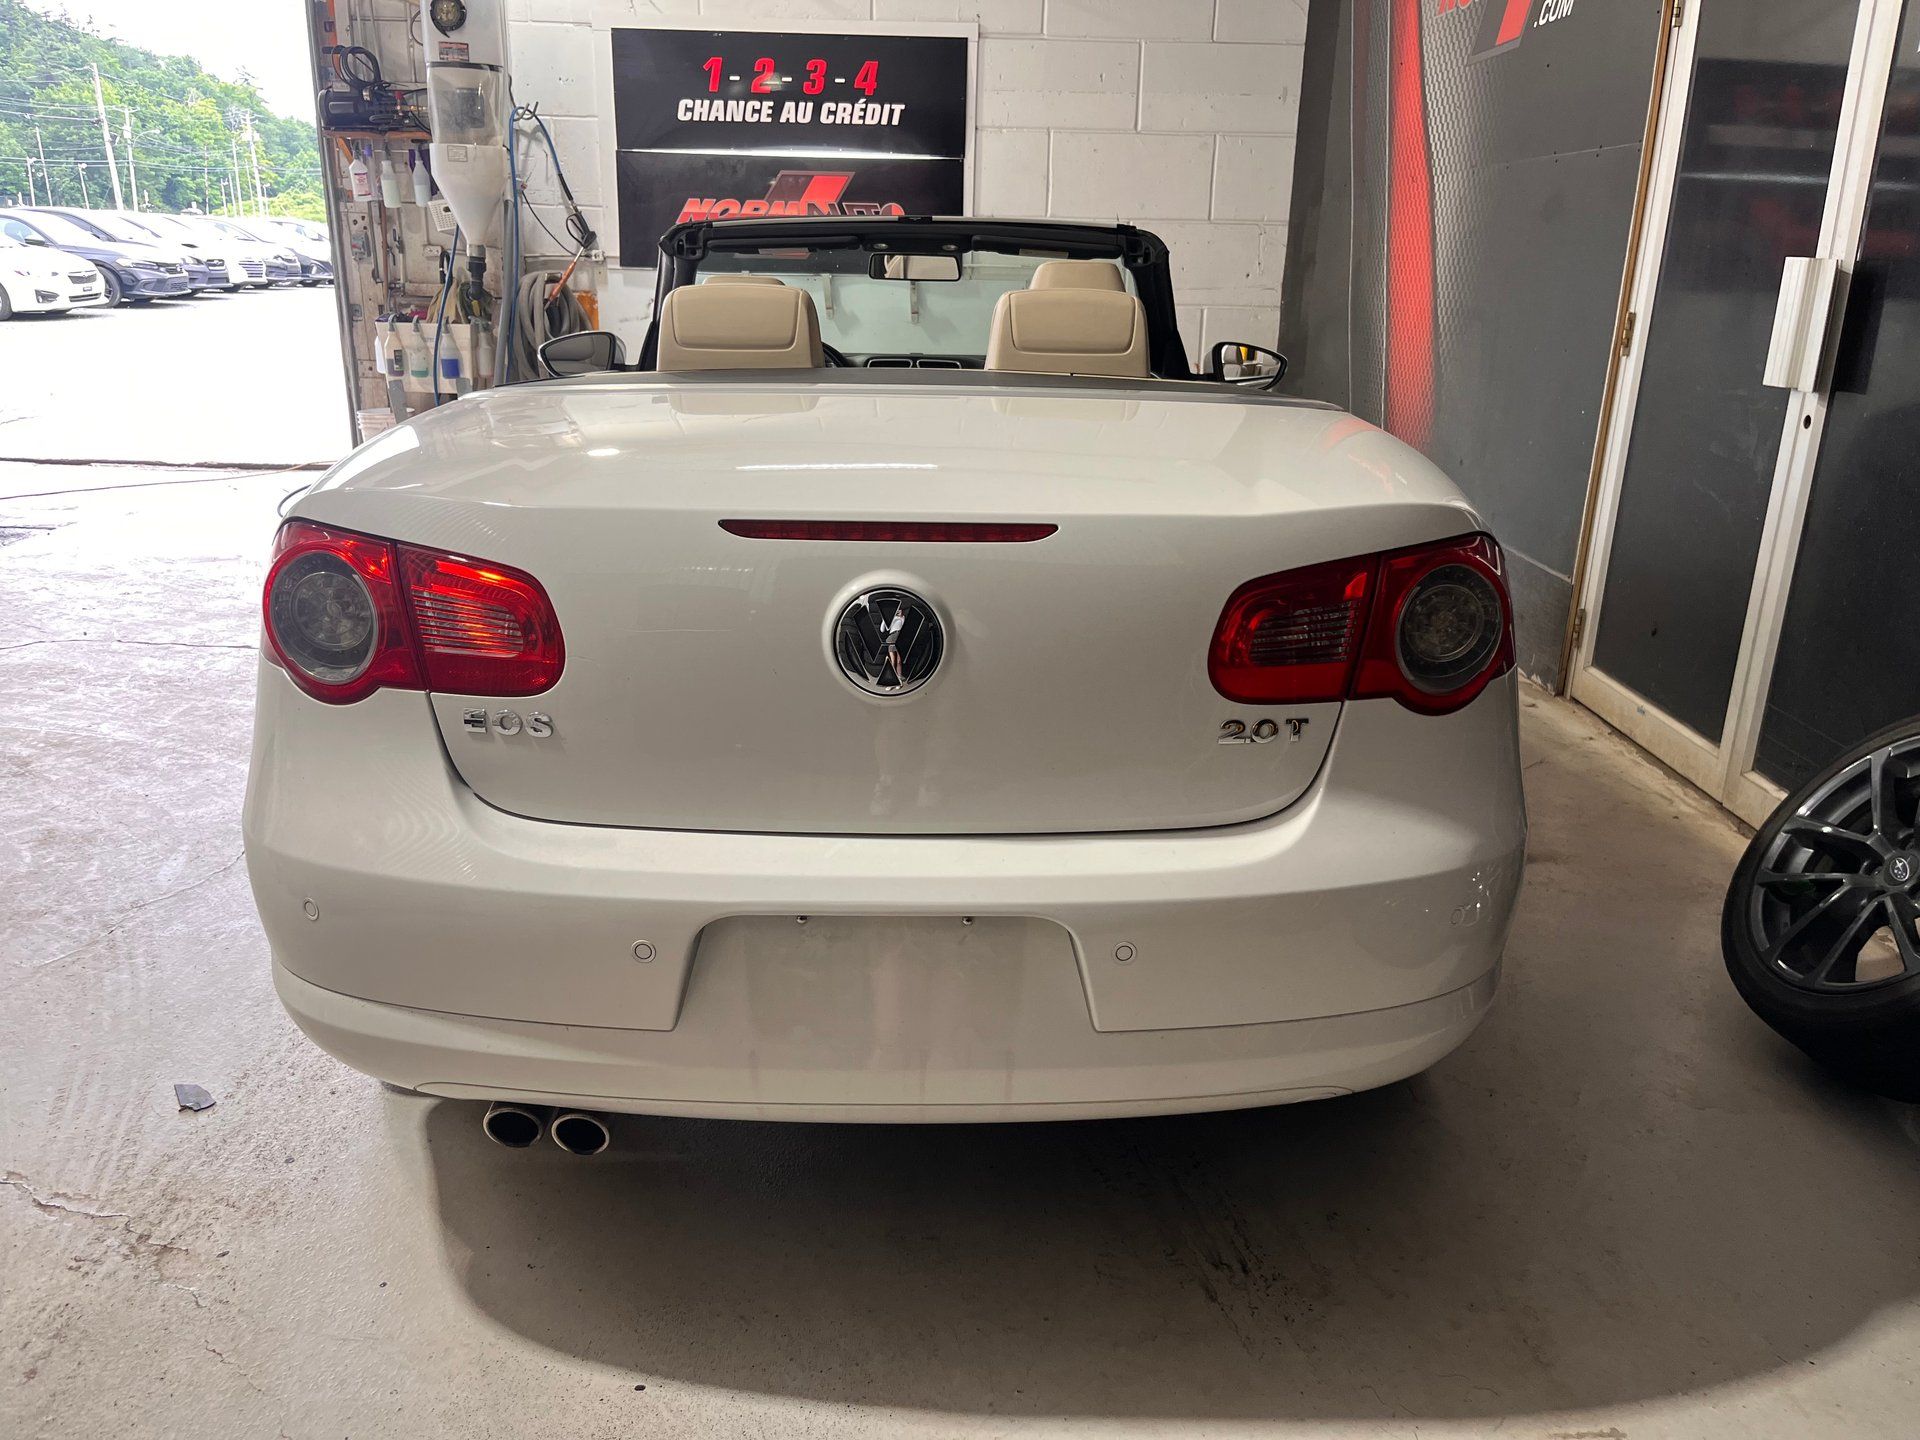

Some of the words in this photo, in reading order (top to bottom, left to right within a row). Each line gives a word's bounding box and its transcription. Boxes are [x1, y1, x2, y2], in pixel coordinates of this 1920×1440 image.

[677, 99, 774, 123] CHANCE
[779, 101, 814, 124] AU
[819, 98, 906, 126] CRÉDIT
[463, 707, 554, 738] EOS
